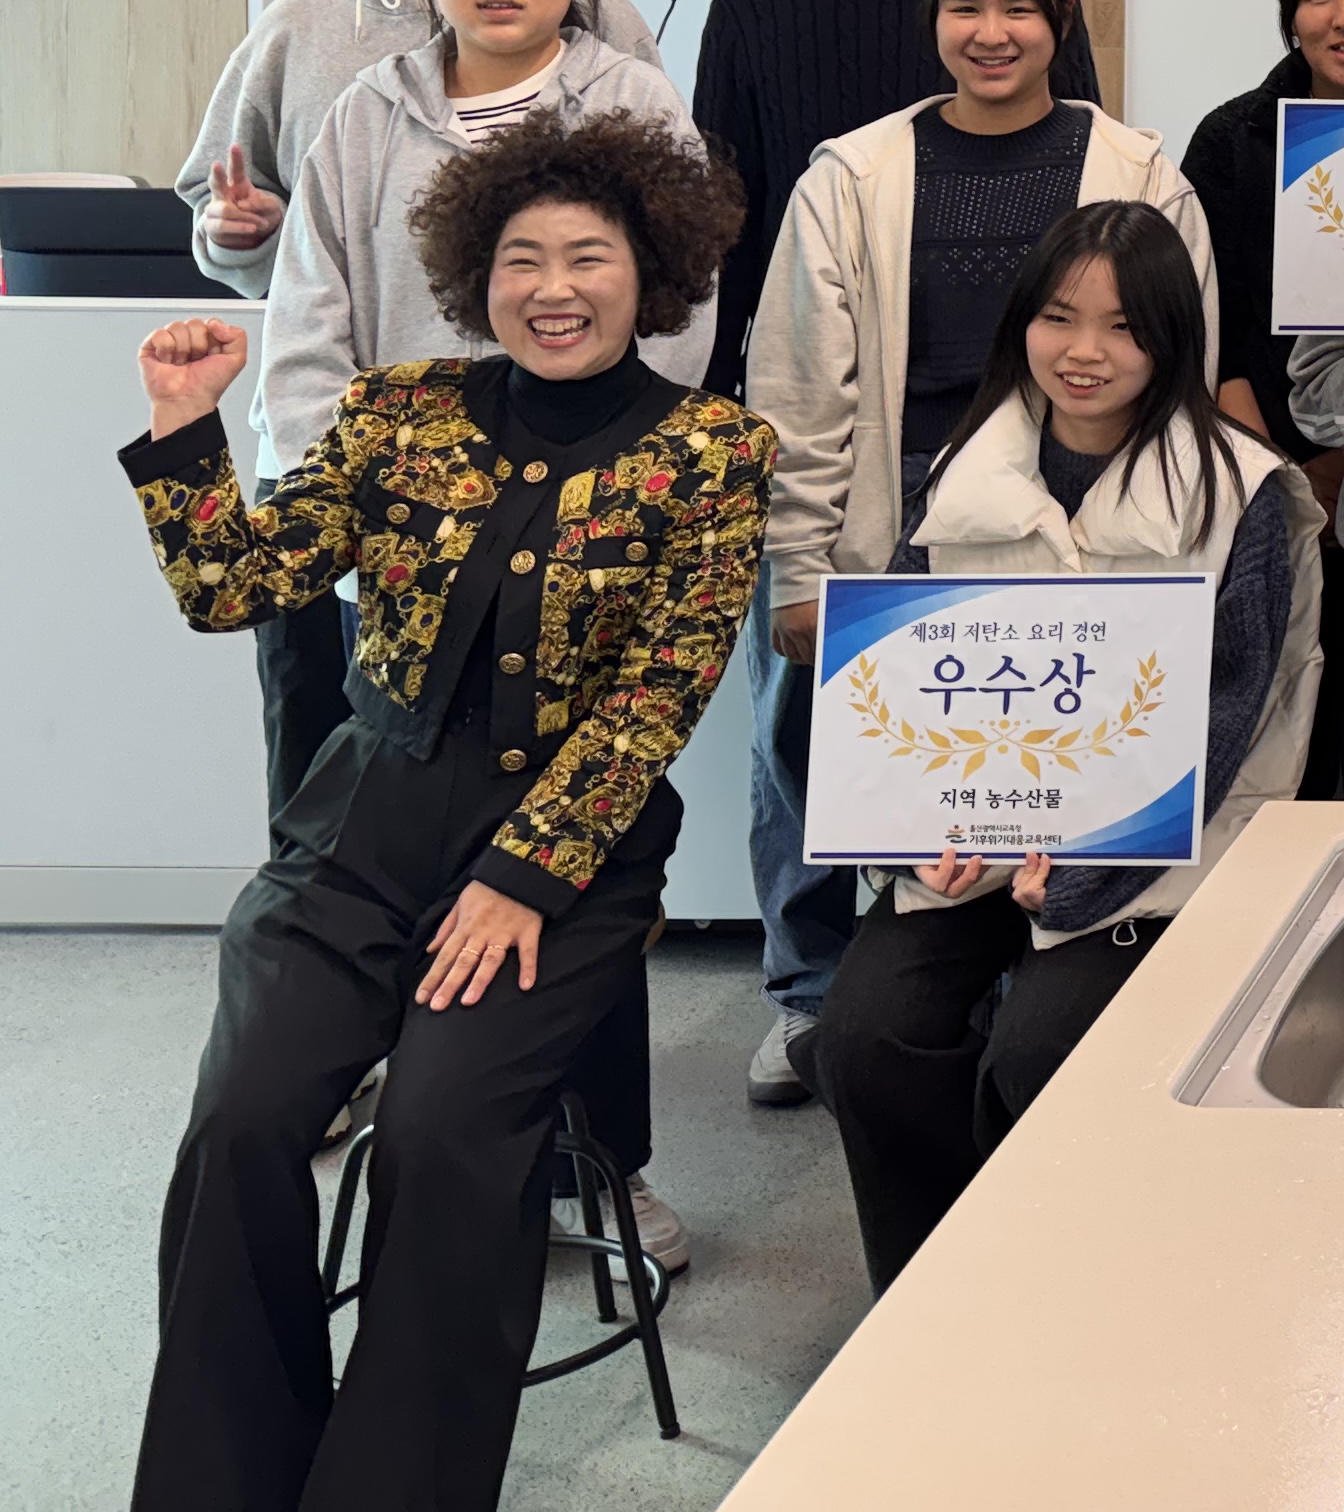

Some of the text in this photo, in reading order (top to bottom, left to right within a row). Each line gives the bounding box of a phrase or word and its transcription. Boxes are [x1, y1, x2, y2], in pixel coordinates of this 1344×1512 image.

[909, 621, 1107, 643] 제3회 저탄소 요리 경연
[919, 653, 1096, 716] 우수상
[939, 788, 1063, 809] 지역 농수산물
[969, 834, 1061, 845] 기후위기대응교육센터
